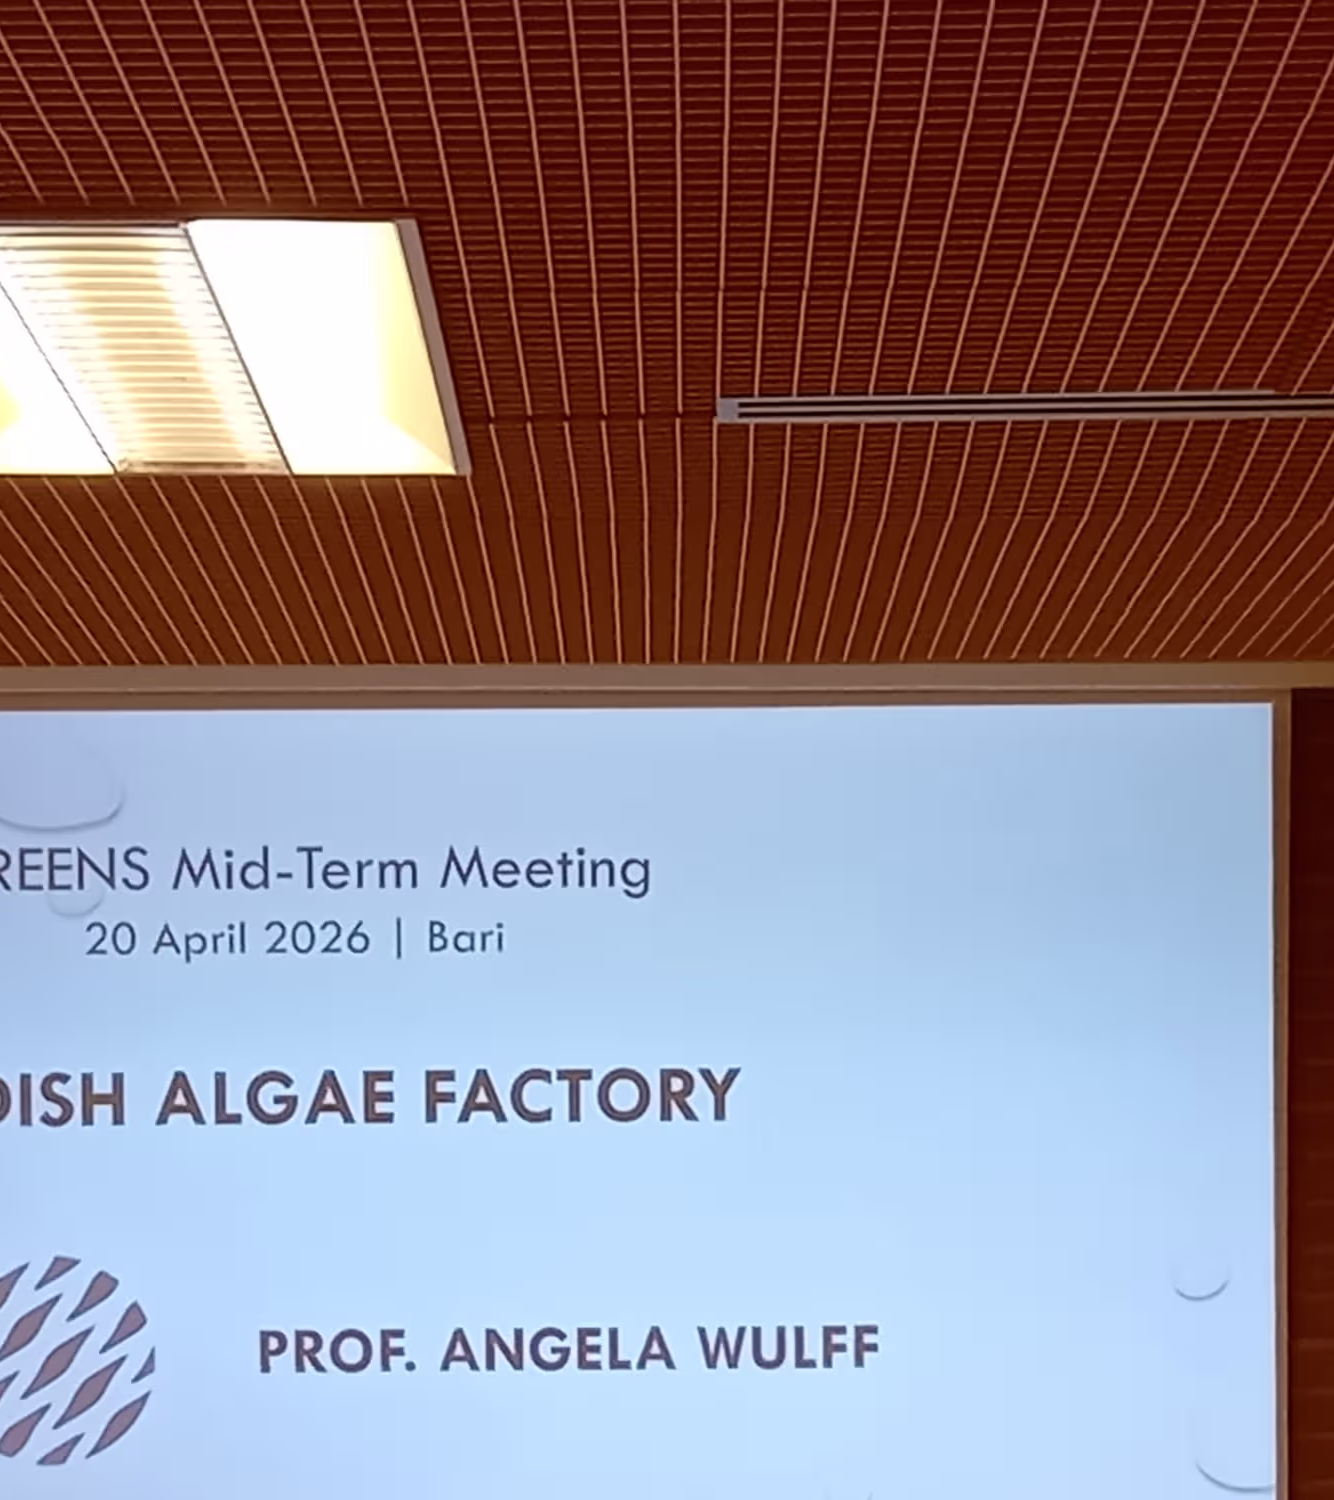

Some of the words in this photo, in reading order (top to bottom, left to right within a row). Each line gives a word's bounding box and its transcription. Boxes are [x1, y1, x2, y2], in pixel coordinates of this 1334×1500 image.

[171, 844, 419, 891] Mid-Term
[439, 844, 651, 900] Meeting
[85, 920, 137, 956] 20
[151, 920, 247, 964] April
[263, 919, 371, 955] 2026
[428, 919, 505, 954] Bari
[154, 1068, 396, 1127] ALGAE
[424, 1066, 742, 1125] FACTORY
[258, 1327, 417, 1375] PROF.
[439, 1325, 678, 1373] ANGELA
[696, 1324, 880, 1371] WULFF
